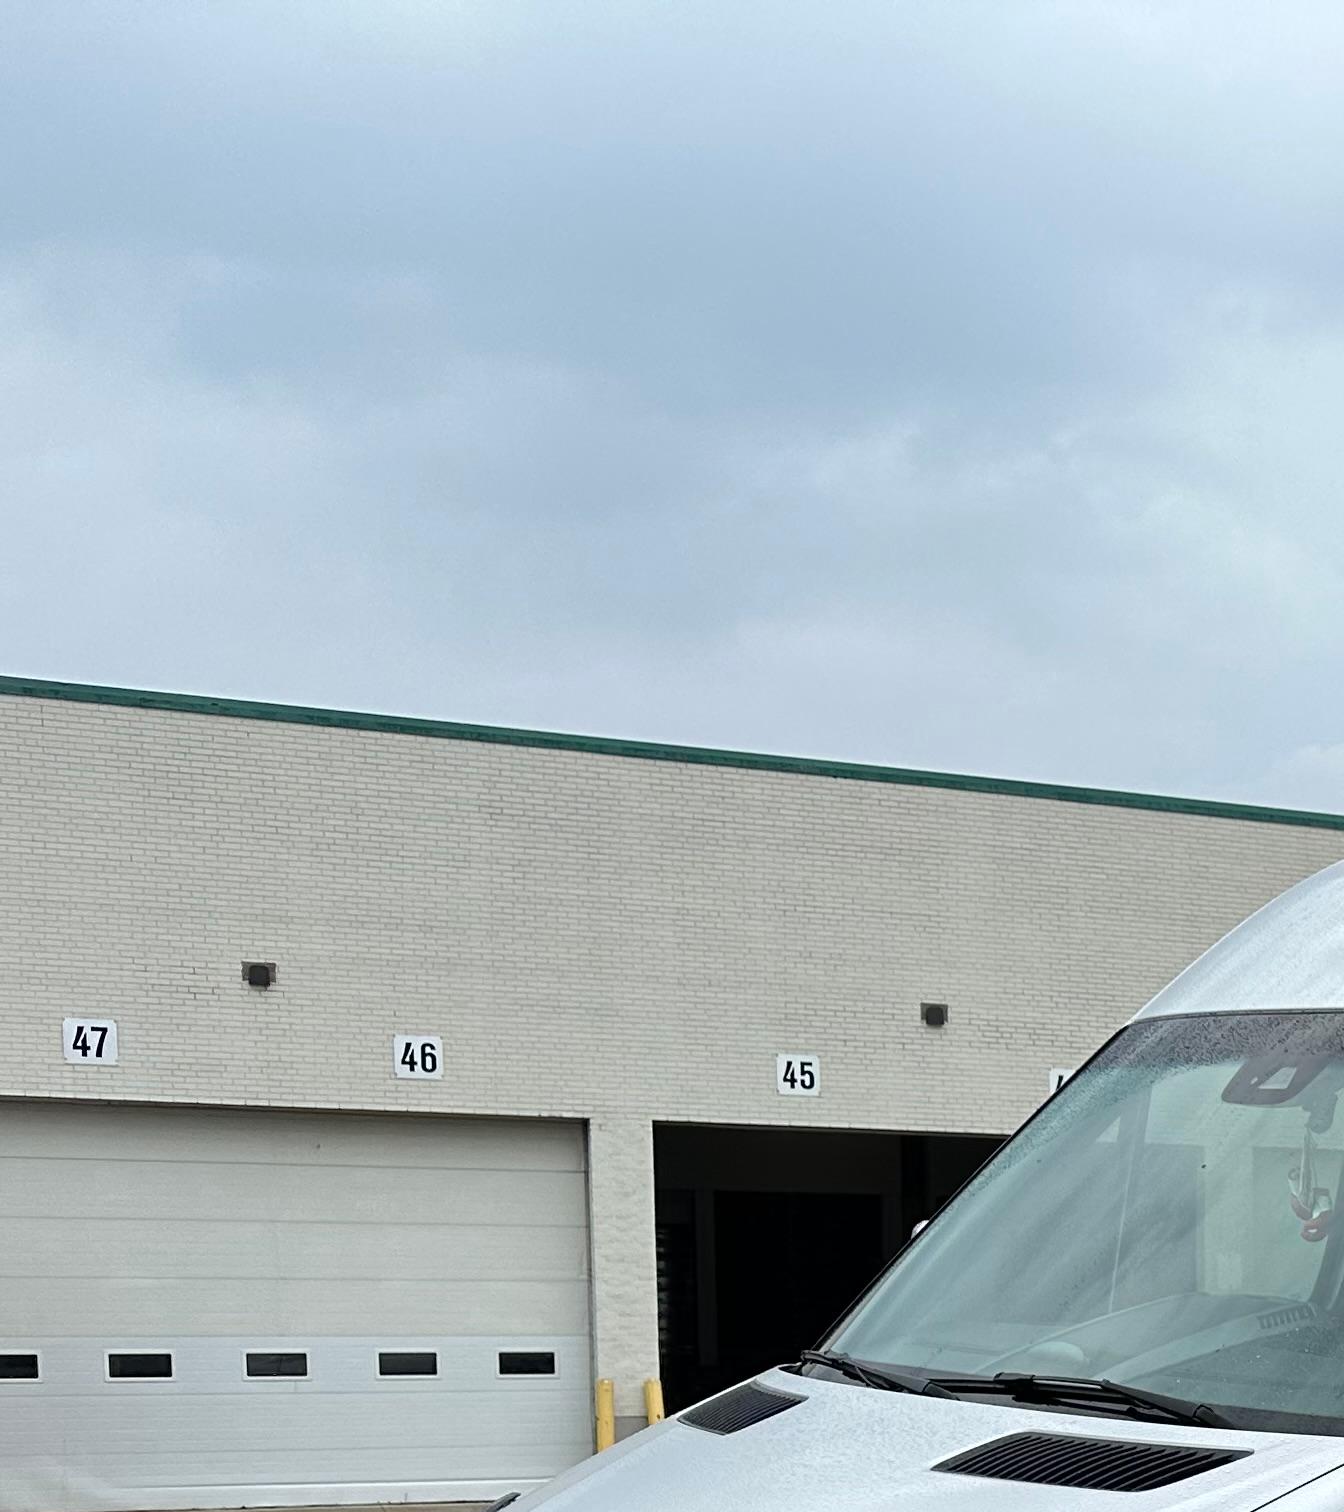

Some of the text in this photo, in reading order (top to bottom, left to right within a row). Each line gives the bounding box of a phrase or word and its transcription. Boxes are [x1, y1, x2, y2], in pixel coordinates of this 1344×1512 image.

[72, 1025, 108, 1058] 47
[401, 1042, 437, 1073] 46
[783, 1060, 815, 1090] 45
